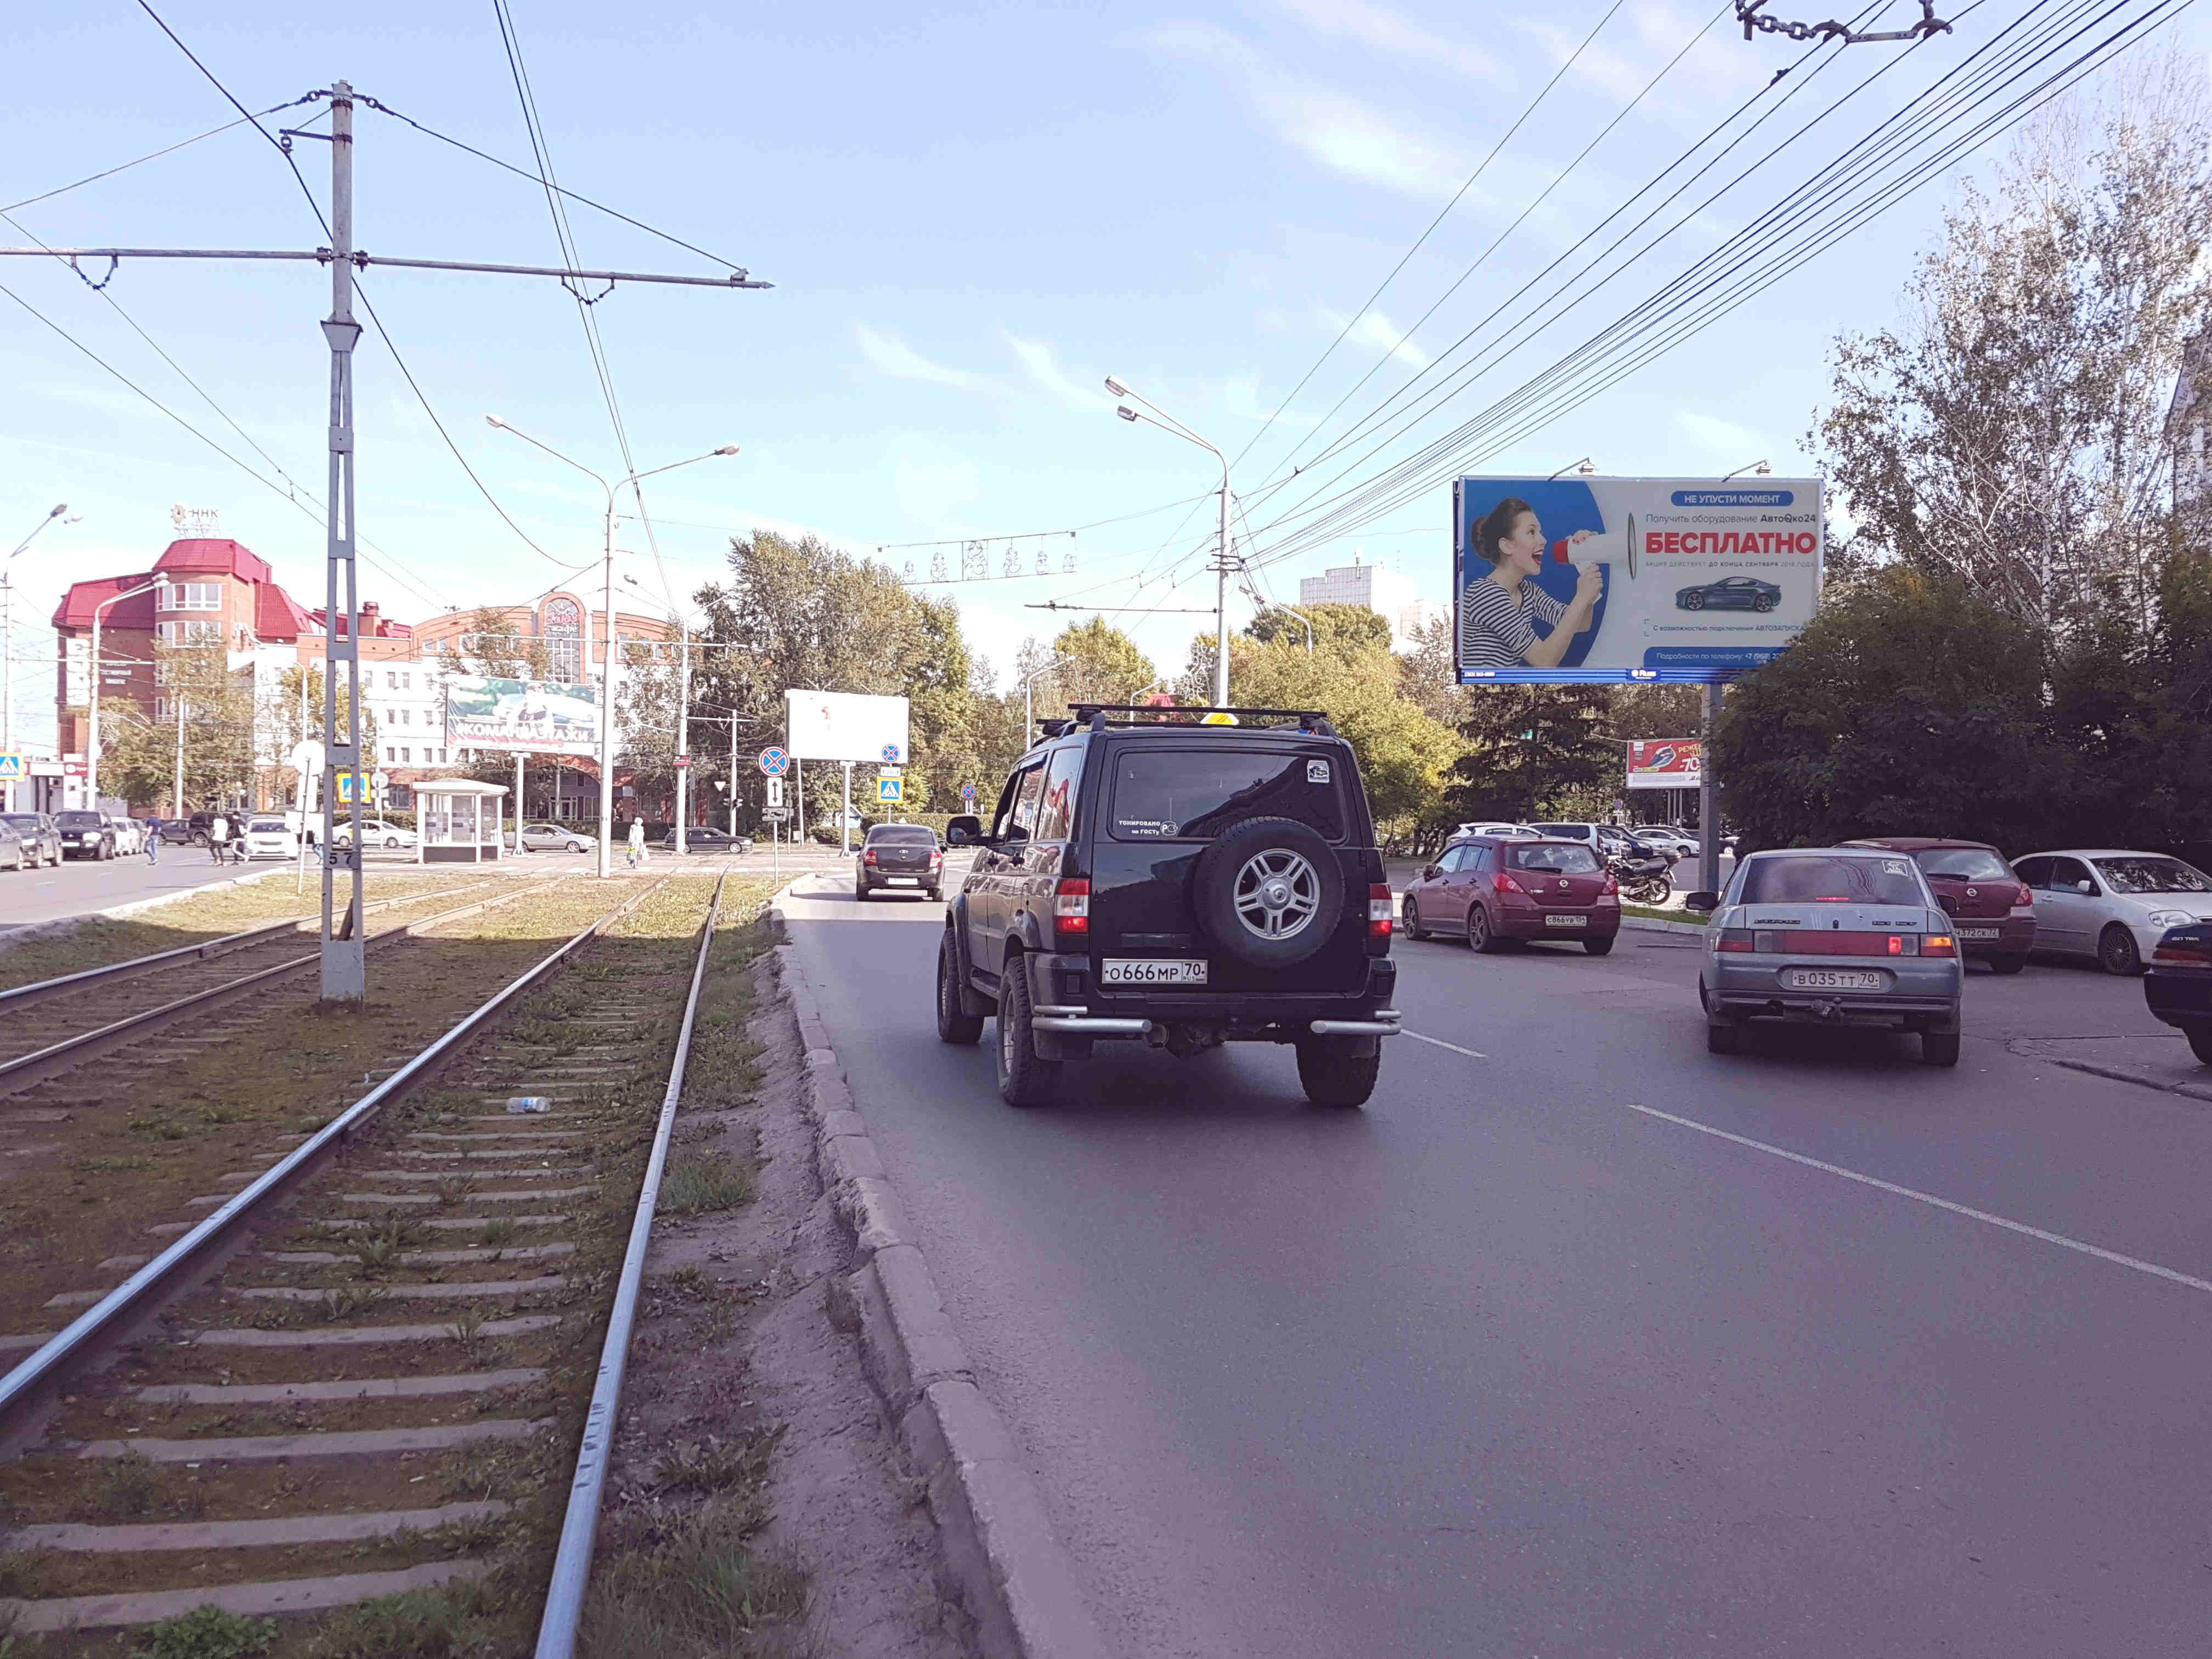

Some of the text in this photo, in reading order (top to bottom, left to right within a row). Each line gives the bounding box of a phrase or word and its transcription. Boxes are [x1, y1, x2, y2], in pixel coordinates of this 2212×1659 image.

[1684, 495, 1780, 504] НЕ УПУСТИ МОМЕНТ
[1646, 514, 1689, 524] Получить
[1692, 515, 1758, 524] оборудование
[1645, 532, 1816, 554] БЕСПЛАТНО
[1656, 652, 1700, 661] Подробности
[1184, 963, 1201, 975] 70
[1860, 973, 1875, 983] 70
